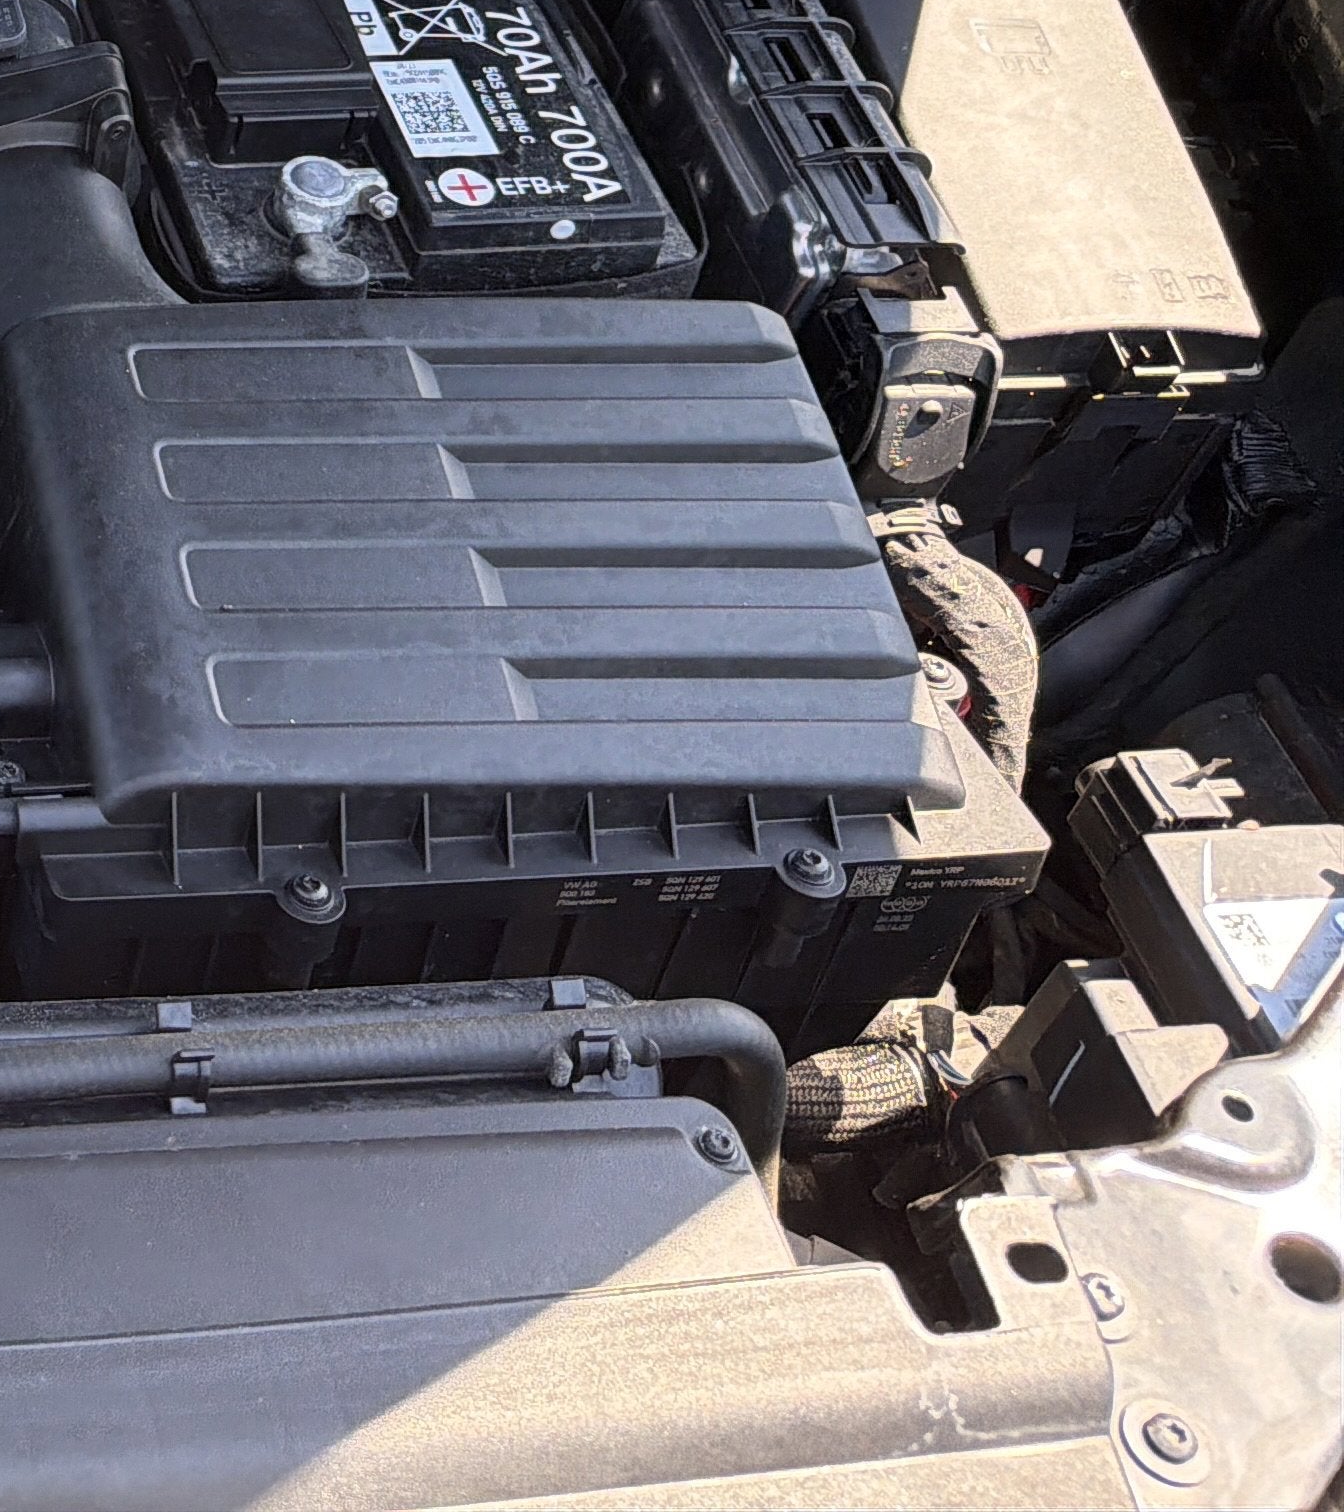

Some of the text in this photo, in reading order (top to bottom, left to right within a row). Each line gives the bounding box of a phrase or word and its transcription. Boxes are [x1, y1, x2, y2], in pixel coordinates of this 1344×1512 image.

[349, 10, 377, 37] Pb
[484, 6, 623, 203] 70Ah 700A
[495, 176, 571, 197] EFB+
